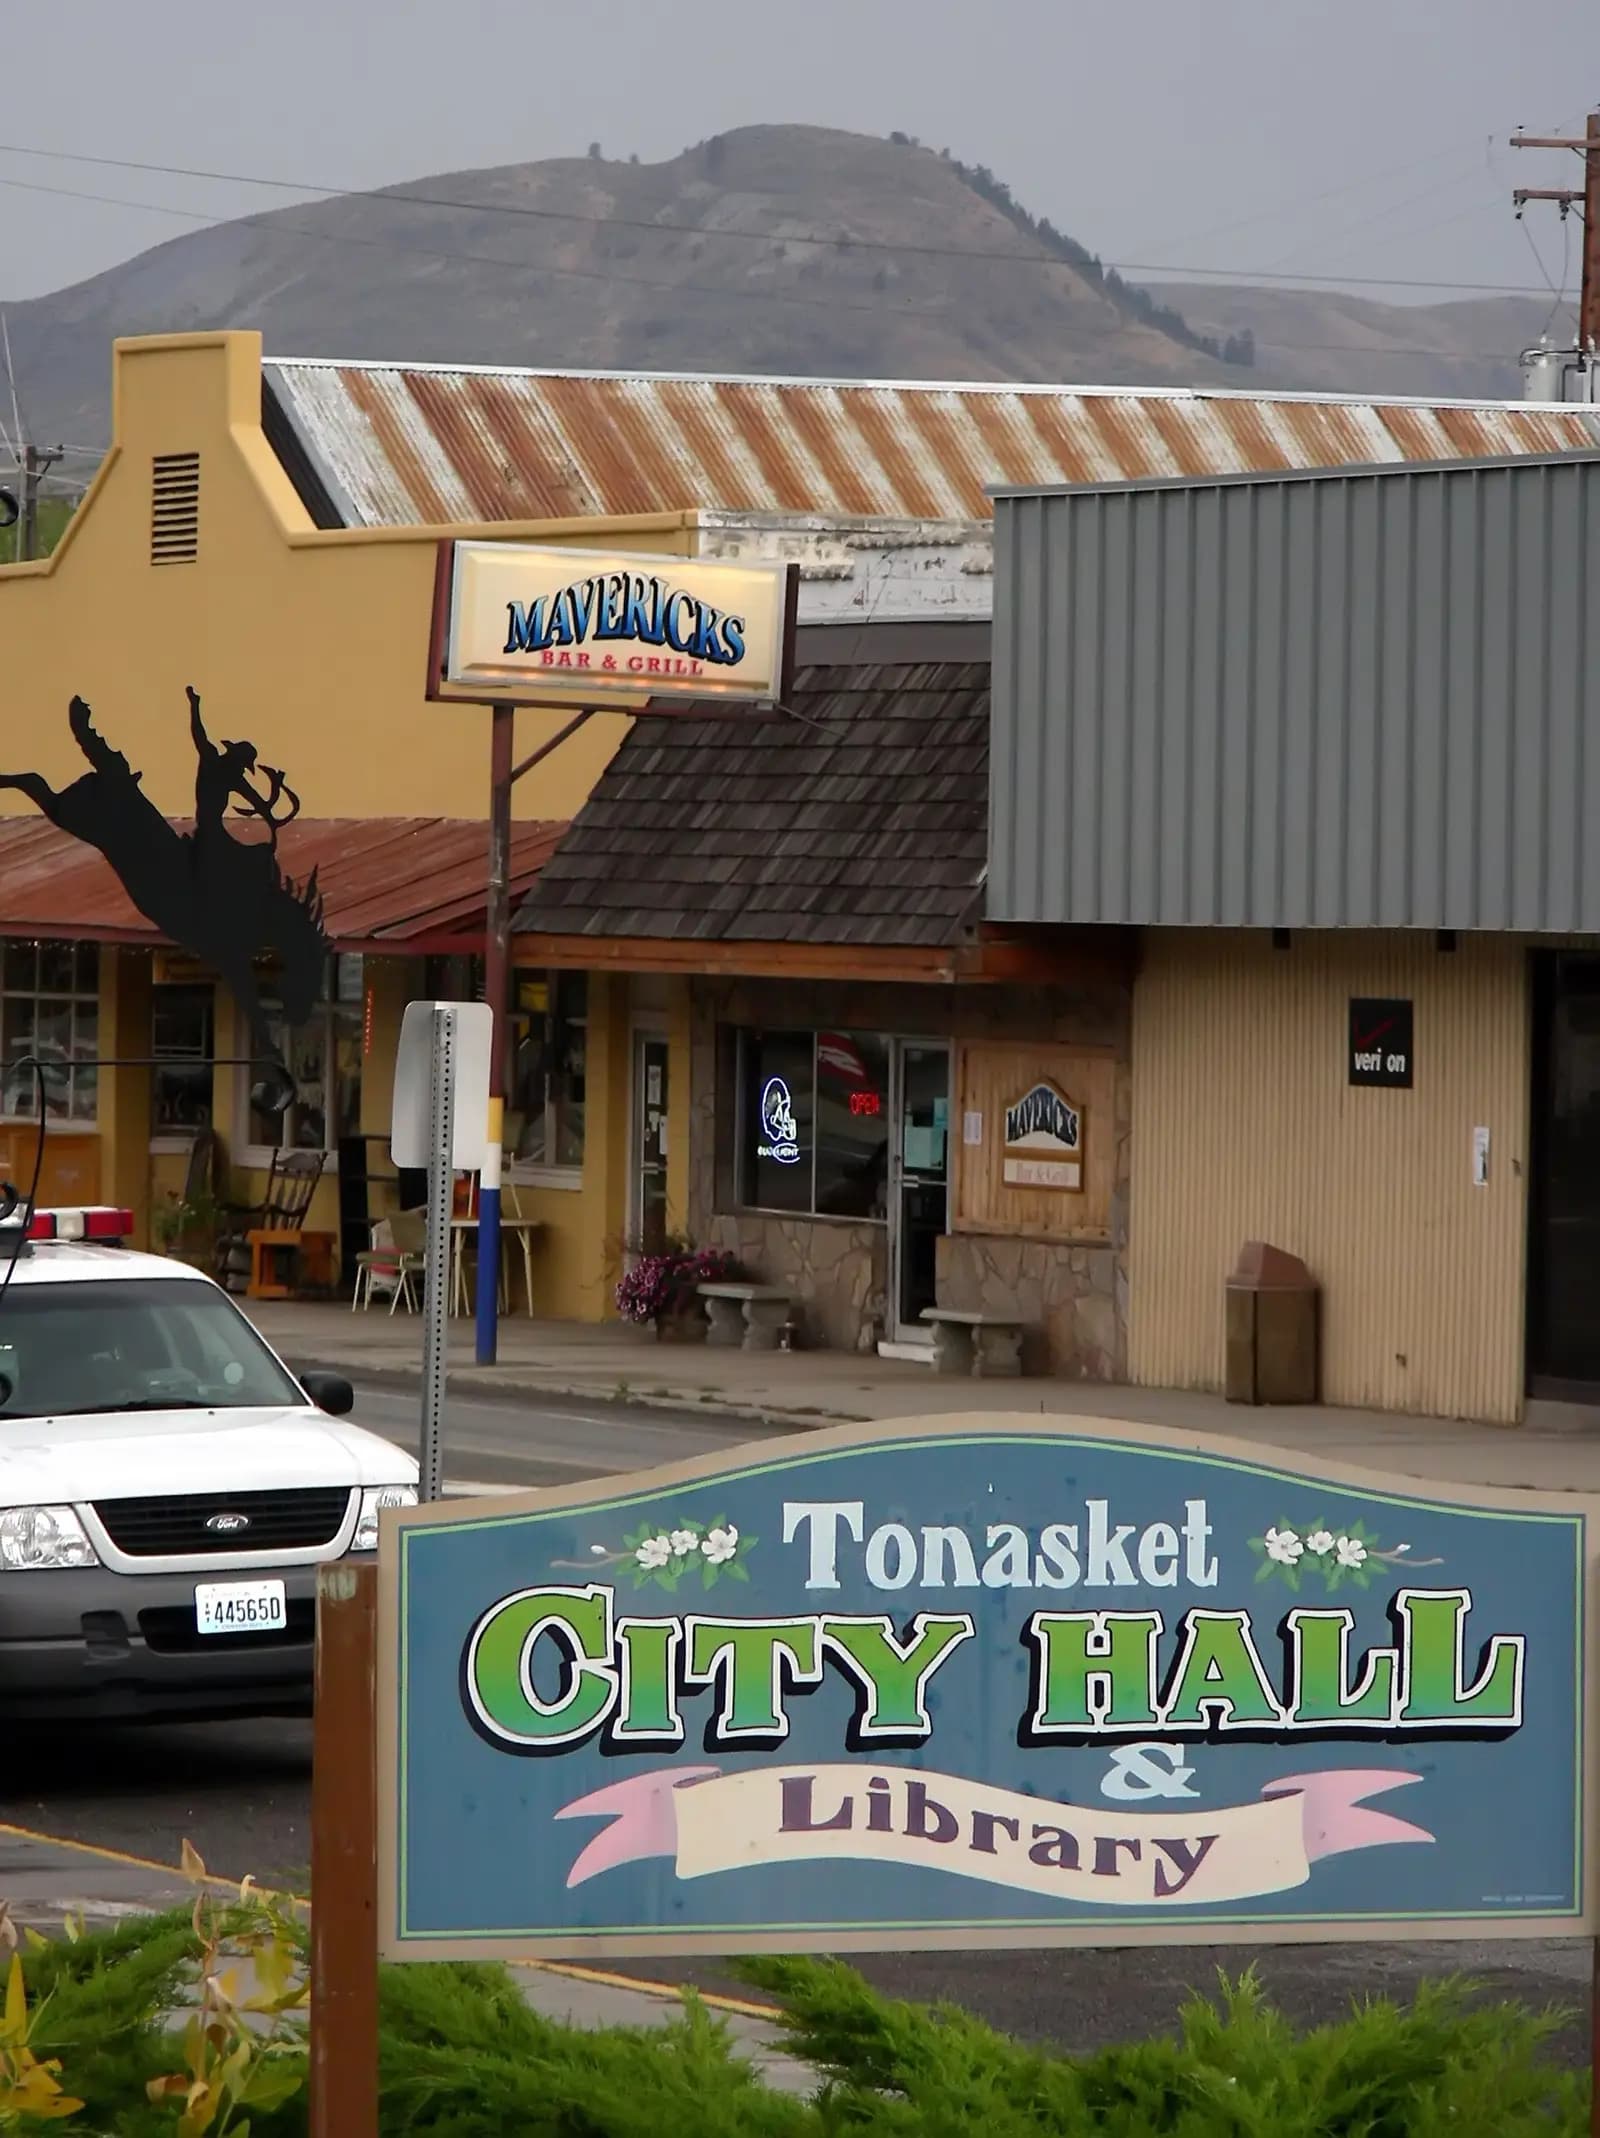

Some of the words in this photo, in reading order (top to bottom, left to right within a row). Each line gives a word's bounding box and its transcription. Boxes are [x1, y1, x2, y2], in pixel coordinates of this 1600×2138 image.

[503, 570, 745, 666] MAVERICKS
[541, 649, 591, 668] BAR
[602, 654, 617, 671] &
[628, 655, 704, 677] GRILL
[849, 1092, 880, 1115] OPEN
[217, 1516, 240, 1529] Ford
[783, 1499, 1219, 1590] Tonasket
[459, 1583, 975, 1757] CITY
[1017, 1588, 1525, 1747] HALL
[1100, 1742, 1200, 1800] &
[779, 1775, 1220, 1897] Library
